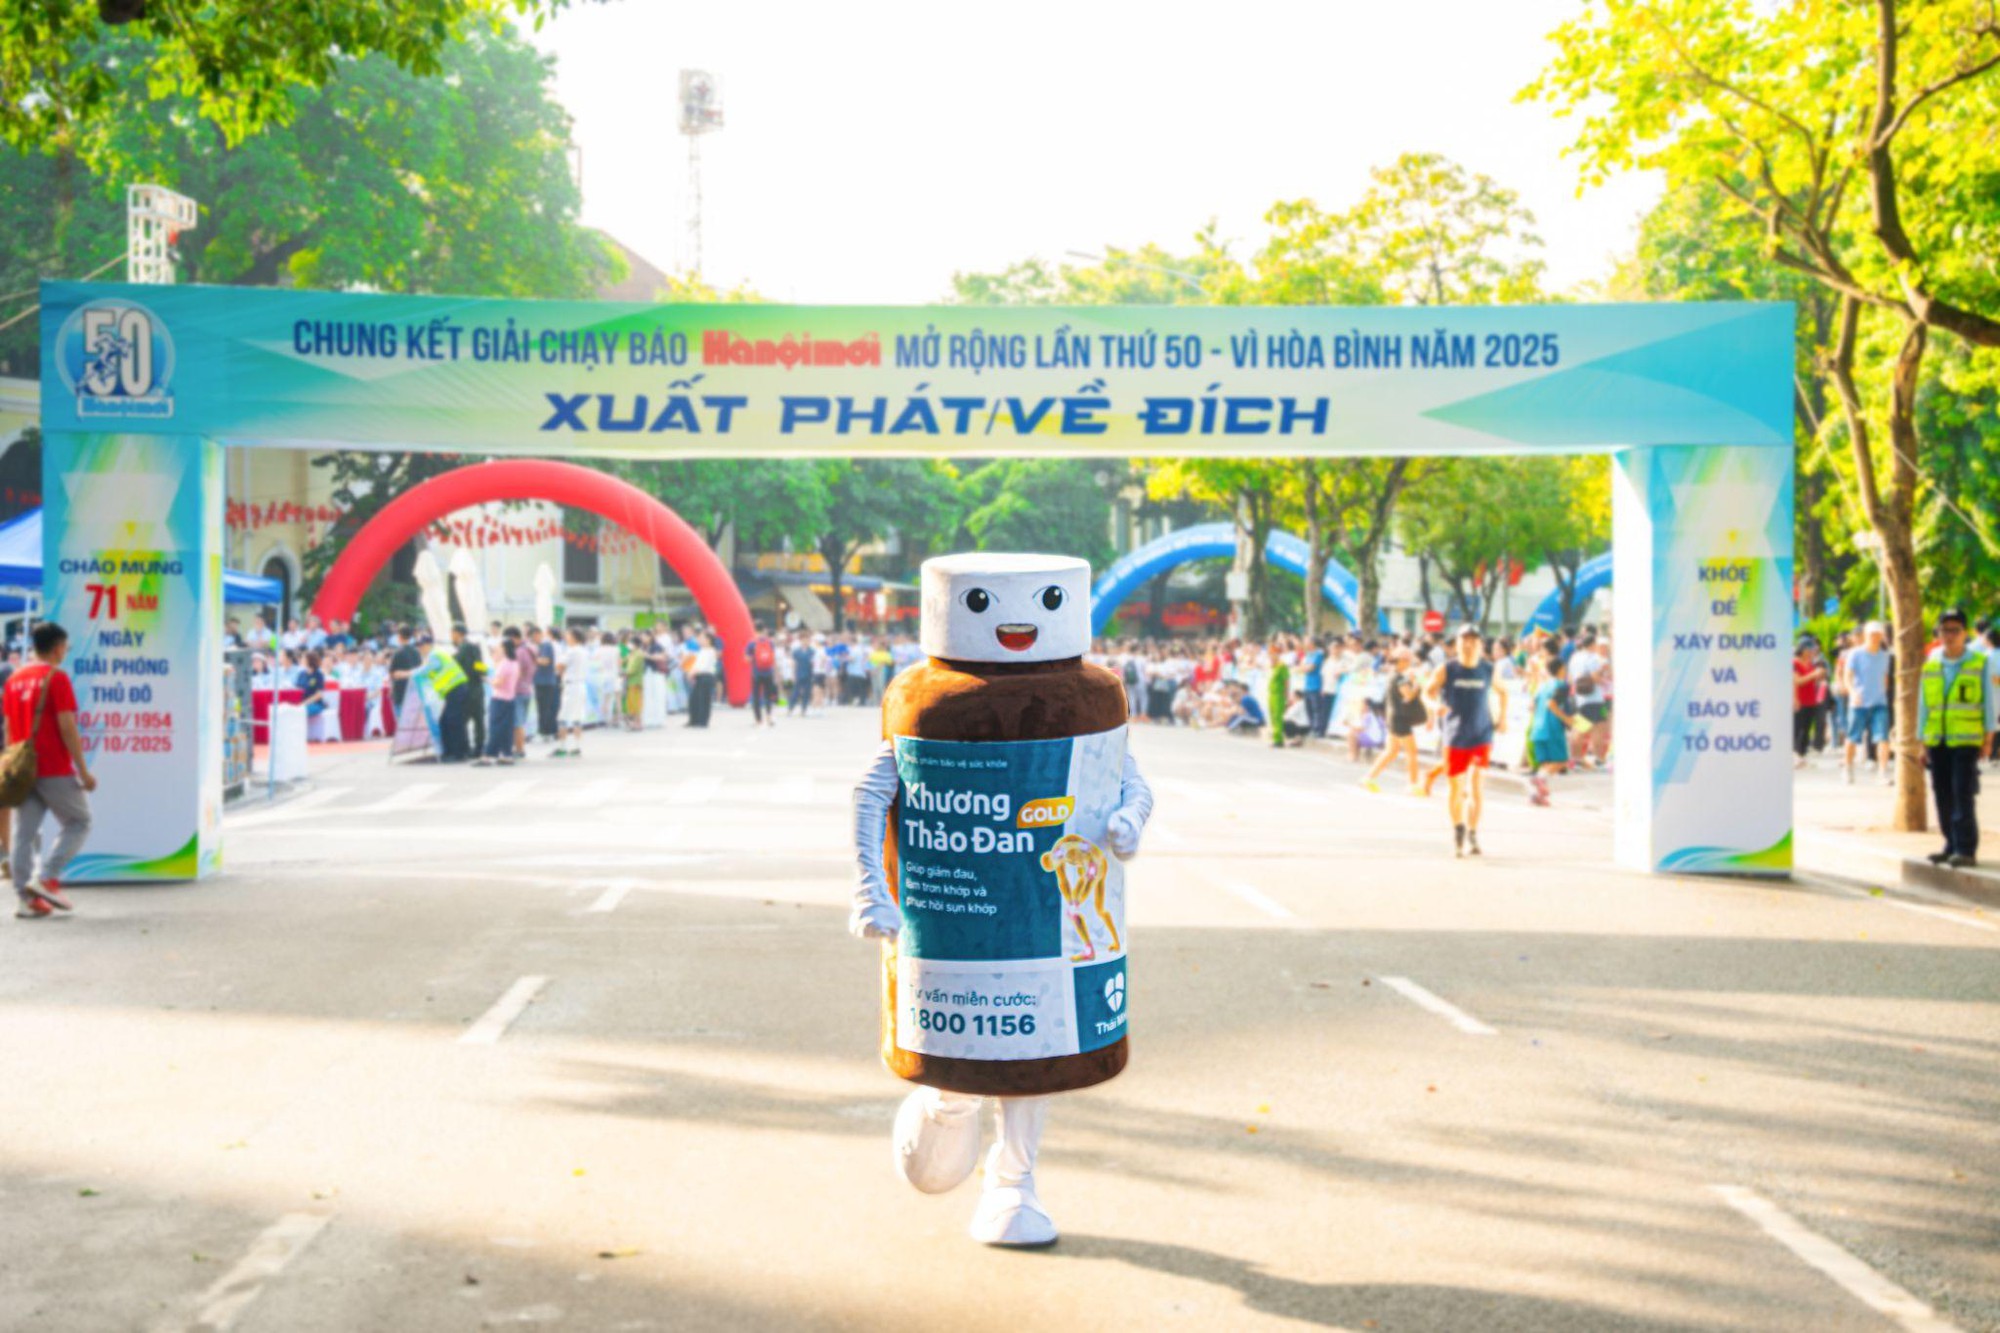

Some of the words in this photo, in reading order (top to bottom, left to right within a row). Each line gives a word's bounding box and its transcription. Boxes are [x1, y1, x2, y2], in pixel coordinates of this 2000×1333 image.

[293, 319, 398, 361] CHUNG
[406, 315, 466, 362] KẾT
[472, 318, 532, 364] GIẢI
[539, 331, 621, 371] CHẠY
[629, 324, 688, 367] BÁO
[896, 324, 942, 368] MỞ
[949, 330, 1026, 375] RỘNG
[1035, 324, 1091, 368] LẦN
[1099, 328, 1158, 368] THỨ
[1164, 334, 1201, 369] 50
[1231, 330, 1258, 368] VÌ
[1267, 328, 1325, 369] HÒA
[1334, 330, 1401, 368] BÌNH
[1410, 331, 1476, 368] NĂM
[1484, 334, 1559, 368] 2025
[539, 374, 748, 432] XUẤT
[1137, 383, 1330, 435] ĐÍCH
[85, 583, 118, 620] 71
[81, 735, 172, 753] 0/10/2025
[905, 782, 1010, 821] Khương
[1021, 804, 1070, 824] GOLD
[904, 818, 967, 853] Thảo
[971, 826, 1035, 853] Đan
[972, 1015, 1036, 1036] 1156
